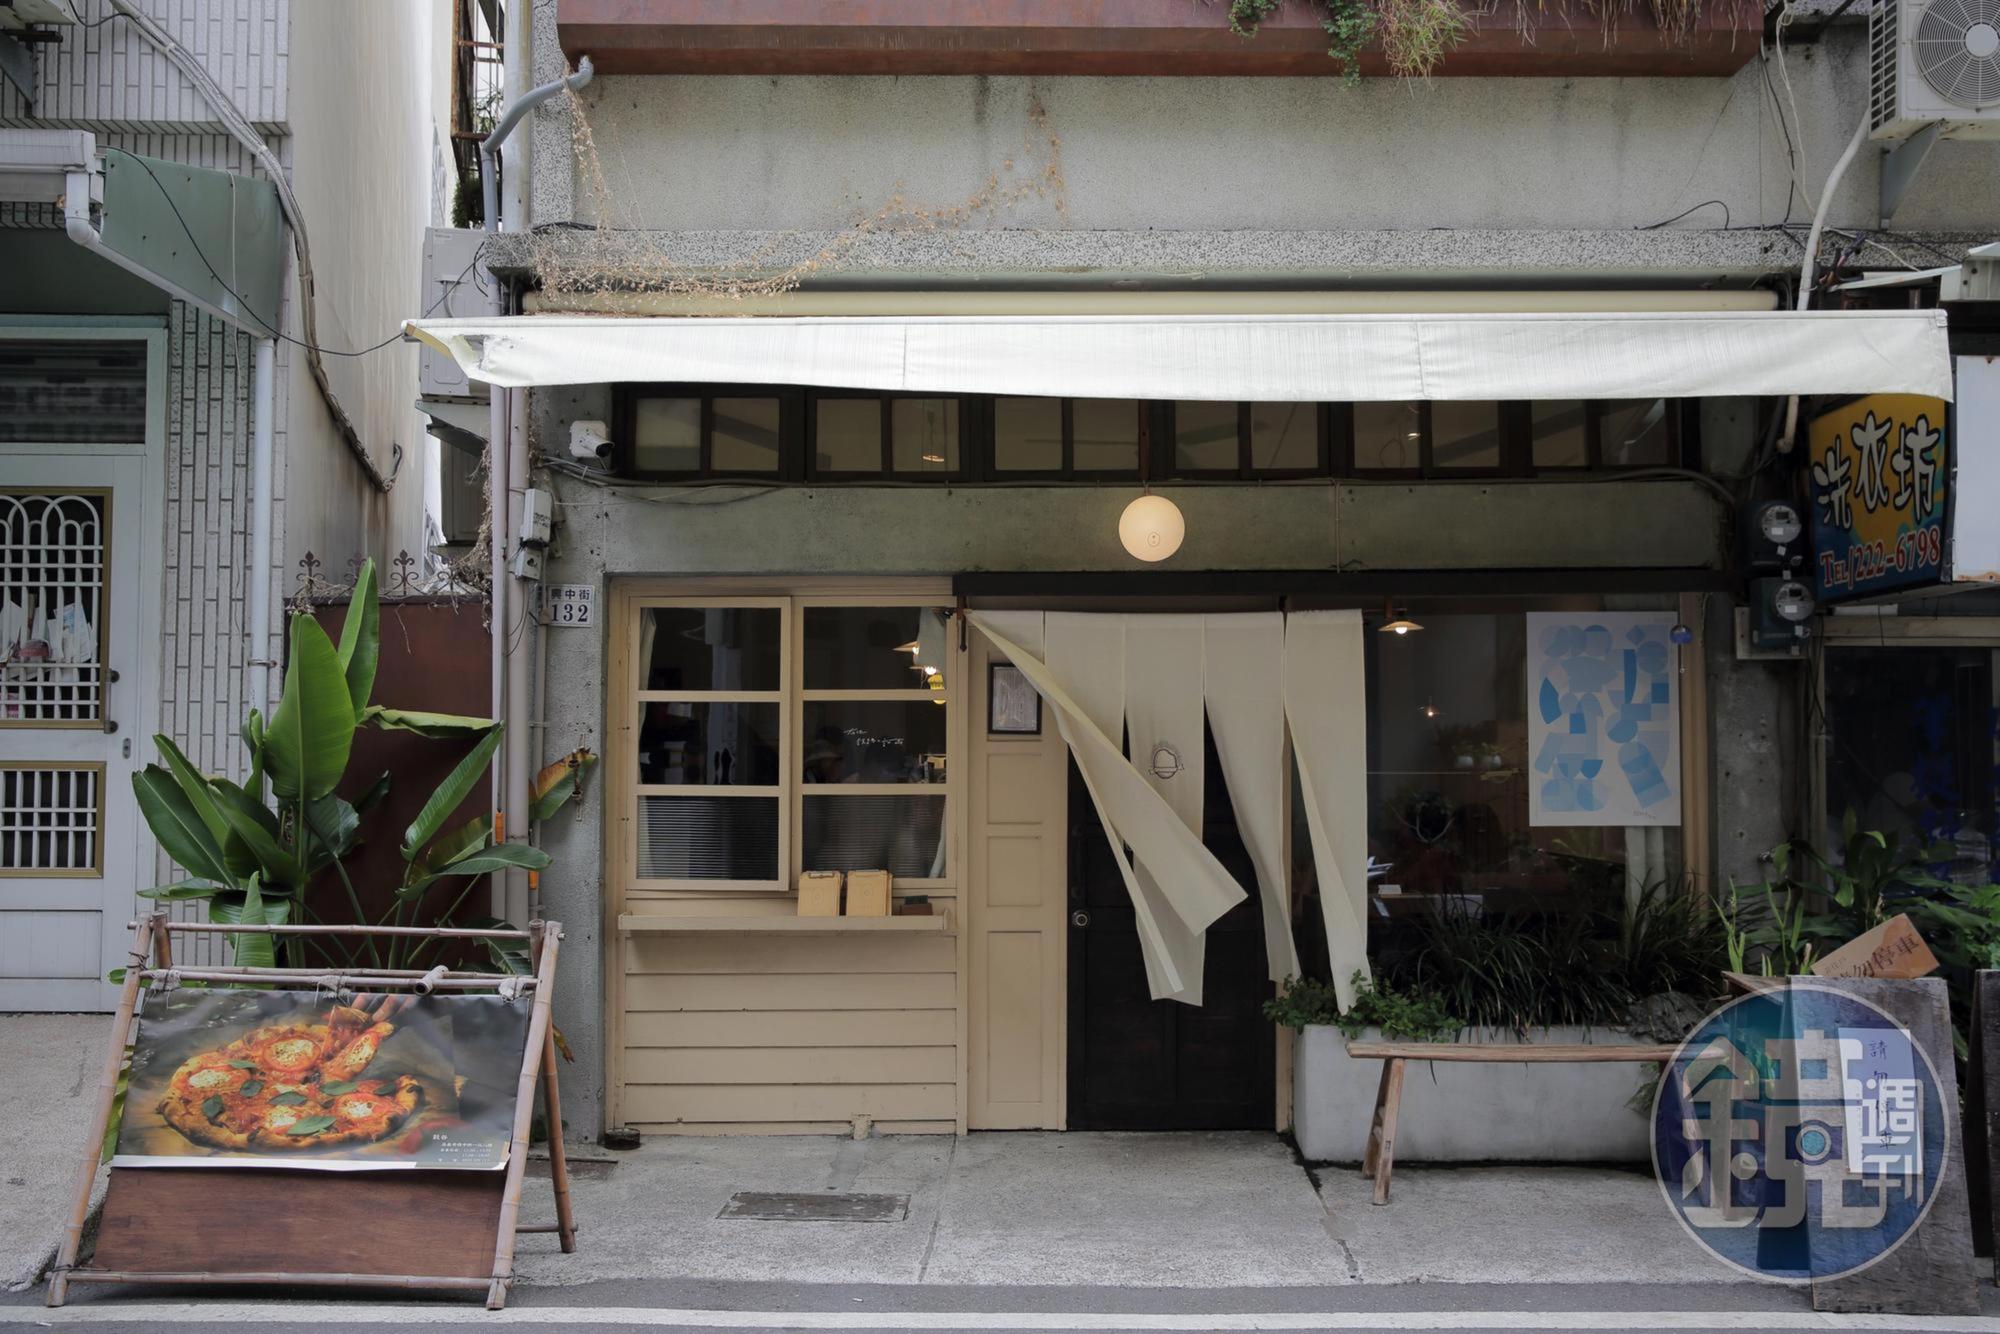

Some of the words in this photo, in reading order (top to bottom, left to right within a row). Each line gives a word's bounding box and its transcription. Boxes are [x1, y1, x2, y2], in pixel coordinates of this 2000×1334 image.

[1812, 409, 1940, 530] 洗衣坊
[551, 588, 591, 601] 興中街
[551, 603, 588, 623] 132
